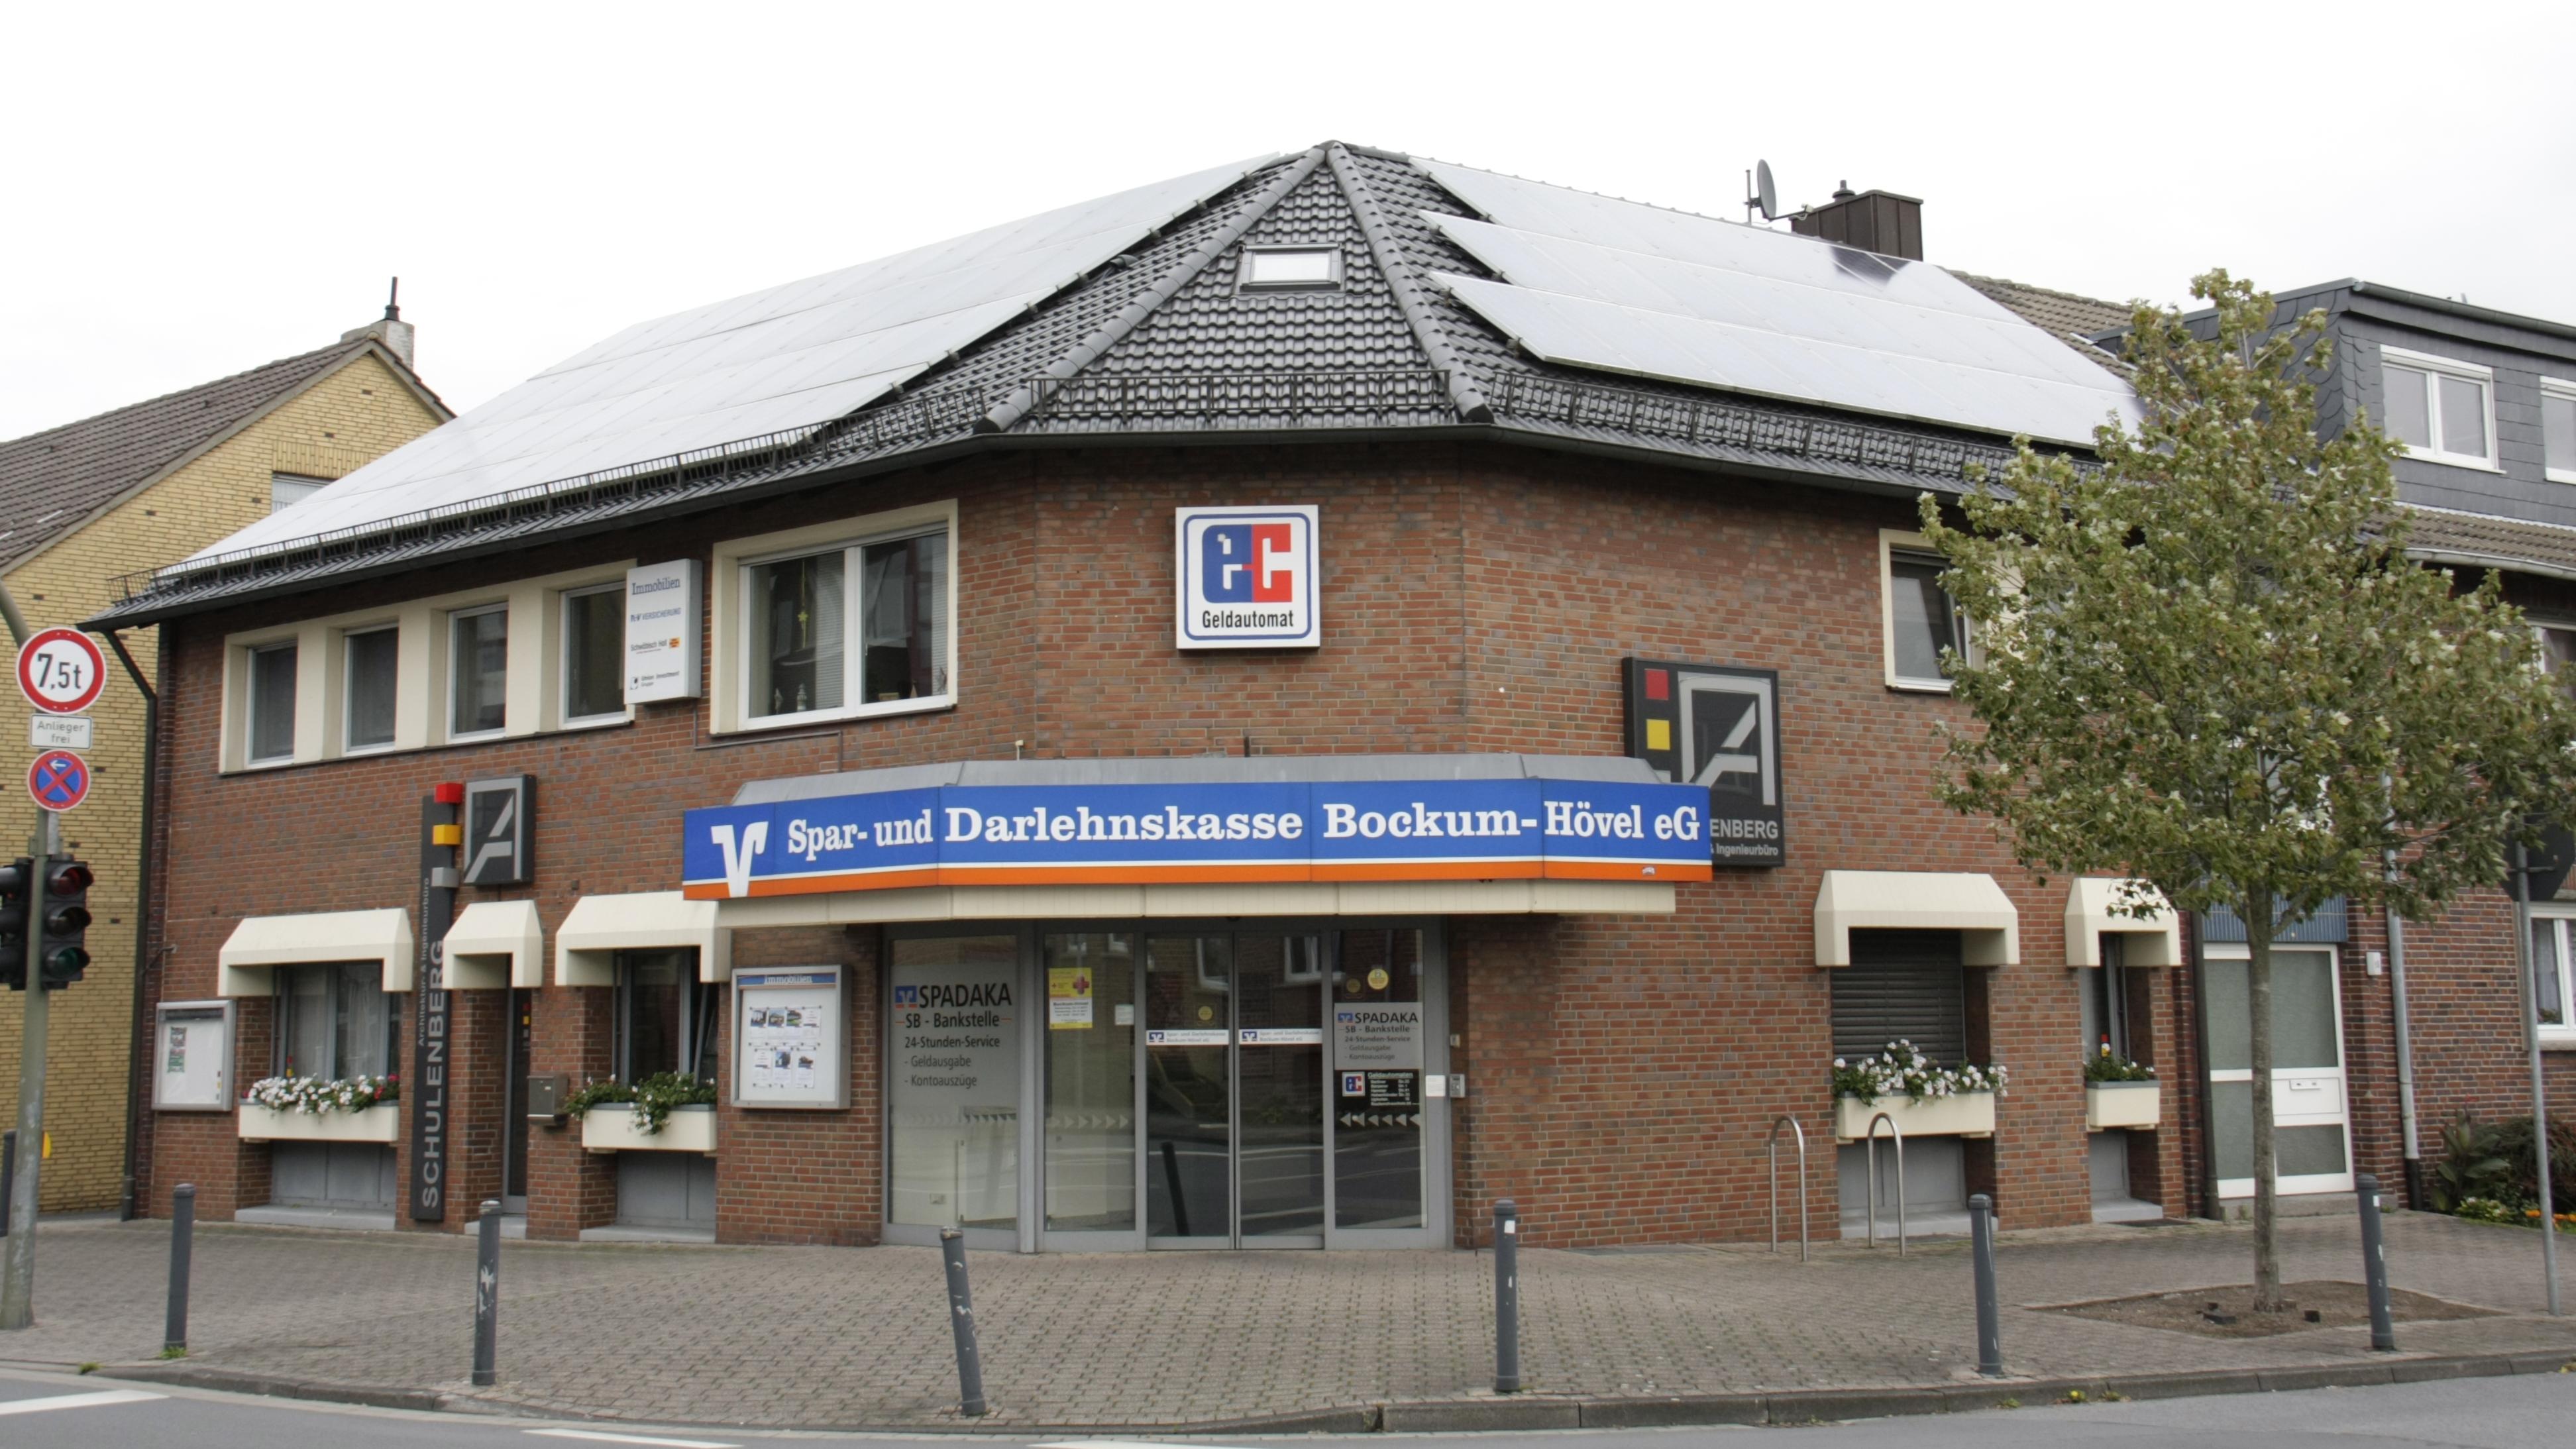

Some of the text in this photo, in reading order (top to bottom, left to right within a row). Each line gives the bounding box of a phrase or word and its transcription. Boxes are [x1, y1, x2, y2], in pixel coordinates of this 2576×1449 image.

[632, 577, 680, 595] Immobilien
[643, 608, 681, 620] VERSICHERUNG
[1203, 610, 1294, 628] Geldautomat
[37, 721, 85, 733] Anlieger
[51, 733, 70, 743] frei
[788, 819, 868, 861] Spar-
[874, 809, 934, 846] und
[945, 806, 1303, 841] Darlehnskasse
[1654, 806, 1700, 841] eG
[1716, 843, 1779, 857] Ingenieurbüro
[421, 877, 430, 961] Ingenieurbüro
[919, 983, 1012, 1008] SPADAKA
[906, 1013, 921, 1028] SB
[934, 1010, 1000, 1028] Bankstelle
[1354, 1012, 1419, 1024] SPADAKA
[904, 1035, 1000, 1048] 24-Stunden-Service
[911, 1054, 972, 1070] Geldausgabe
[422, 940, 445, 1208] SCHULENBERG
[911, 1074, 977, 1089] Kontoauszüge
